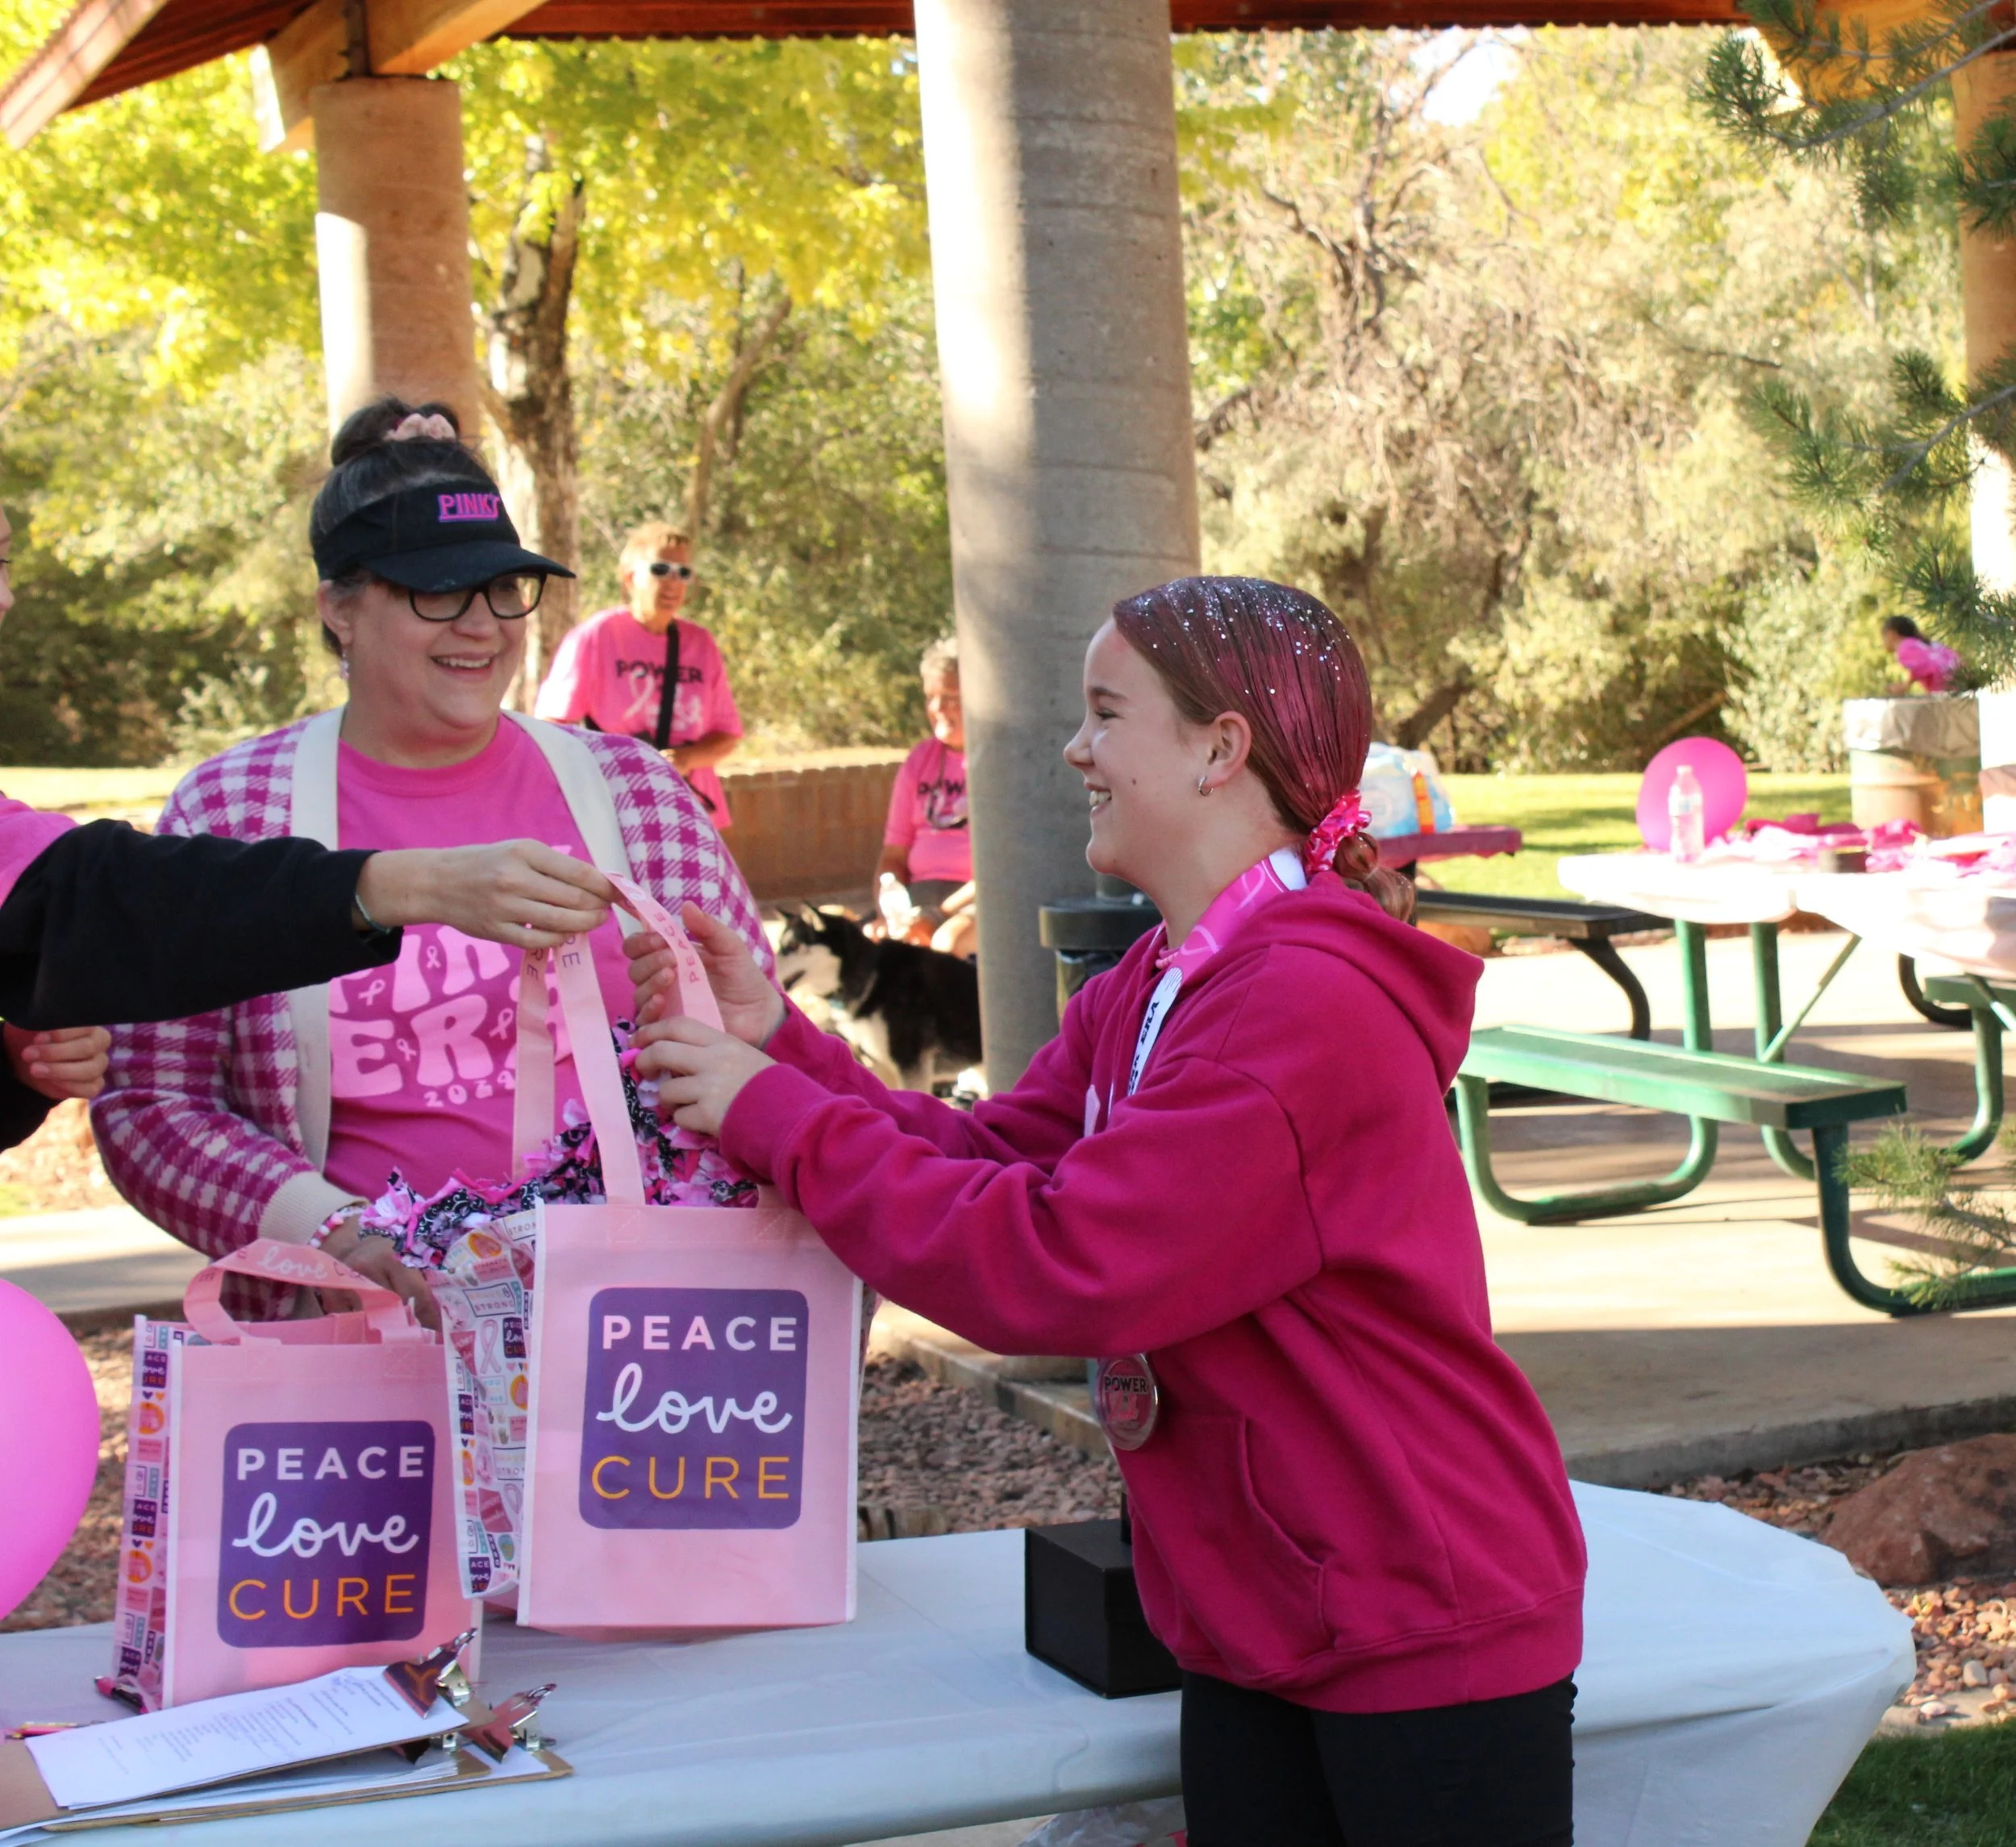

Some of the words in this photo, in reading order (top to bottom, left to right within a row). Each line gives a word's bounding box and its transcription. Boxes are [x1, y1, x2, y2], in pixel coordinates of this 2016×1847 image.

[654, 912, 700, 984] PEACE
[256, 1246, 327, 1279] love
[602, 1315, 797, 1351] PEACE
[595, 1362, 793, 1434] love
[1103, 1375, 1148, 1393] POWER
[237, 1446, 425, 1481] PEACE
[591, 1455, 790, 1500] CURE
[231, 1491, 419, 1558] love
[228, 1574, 416, 1620] CURE
